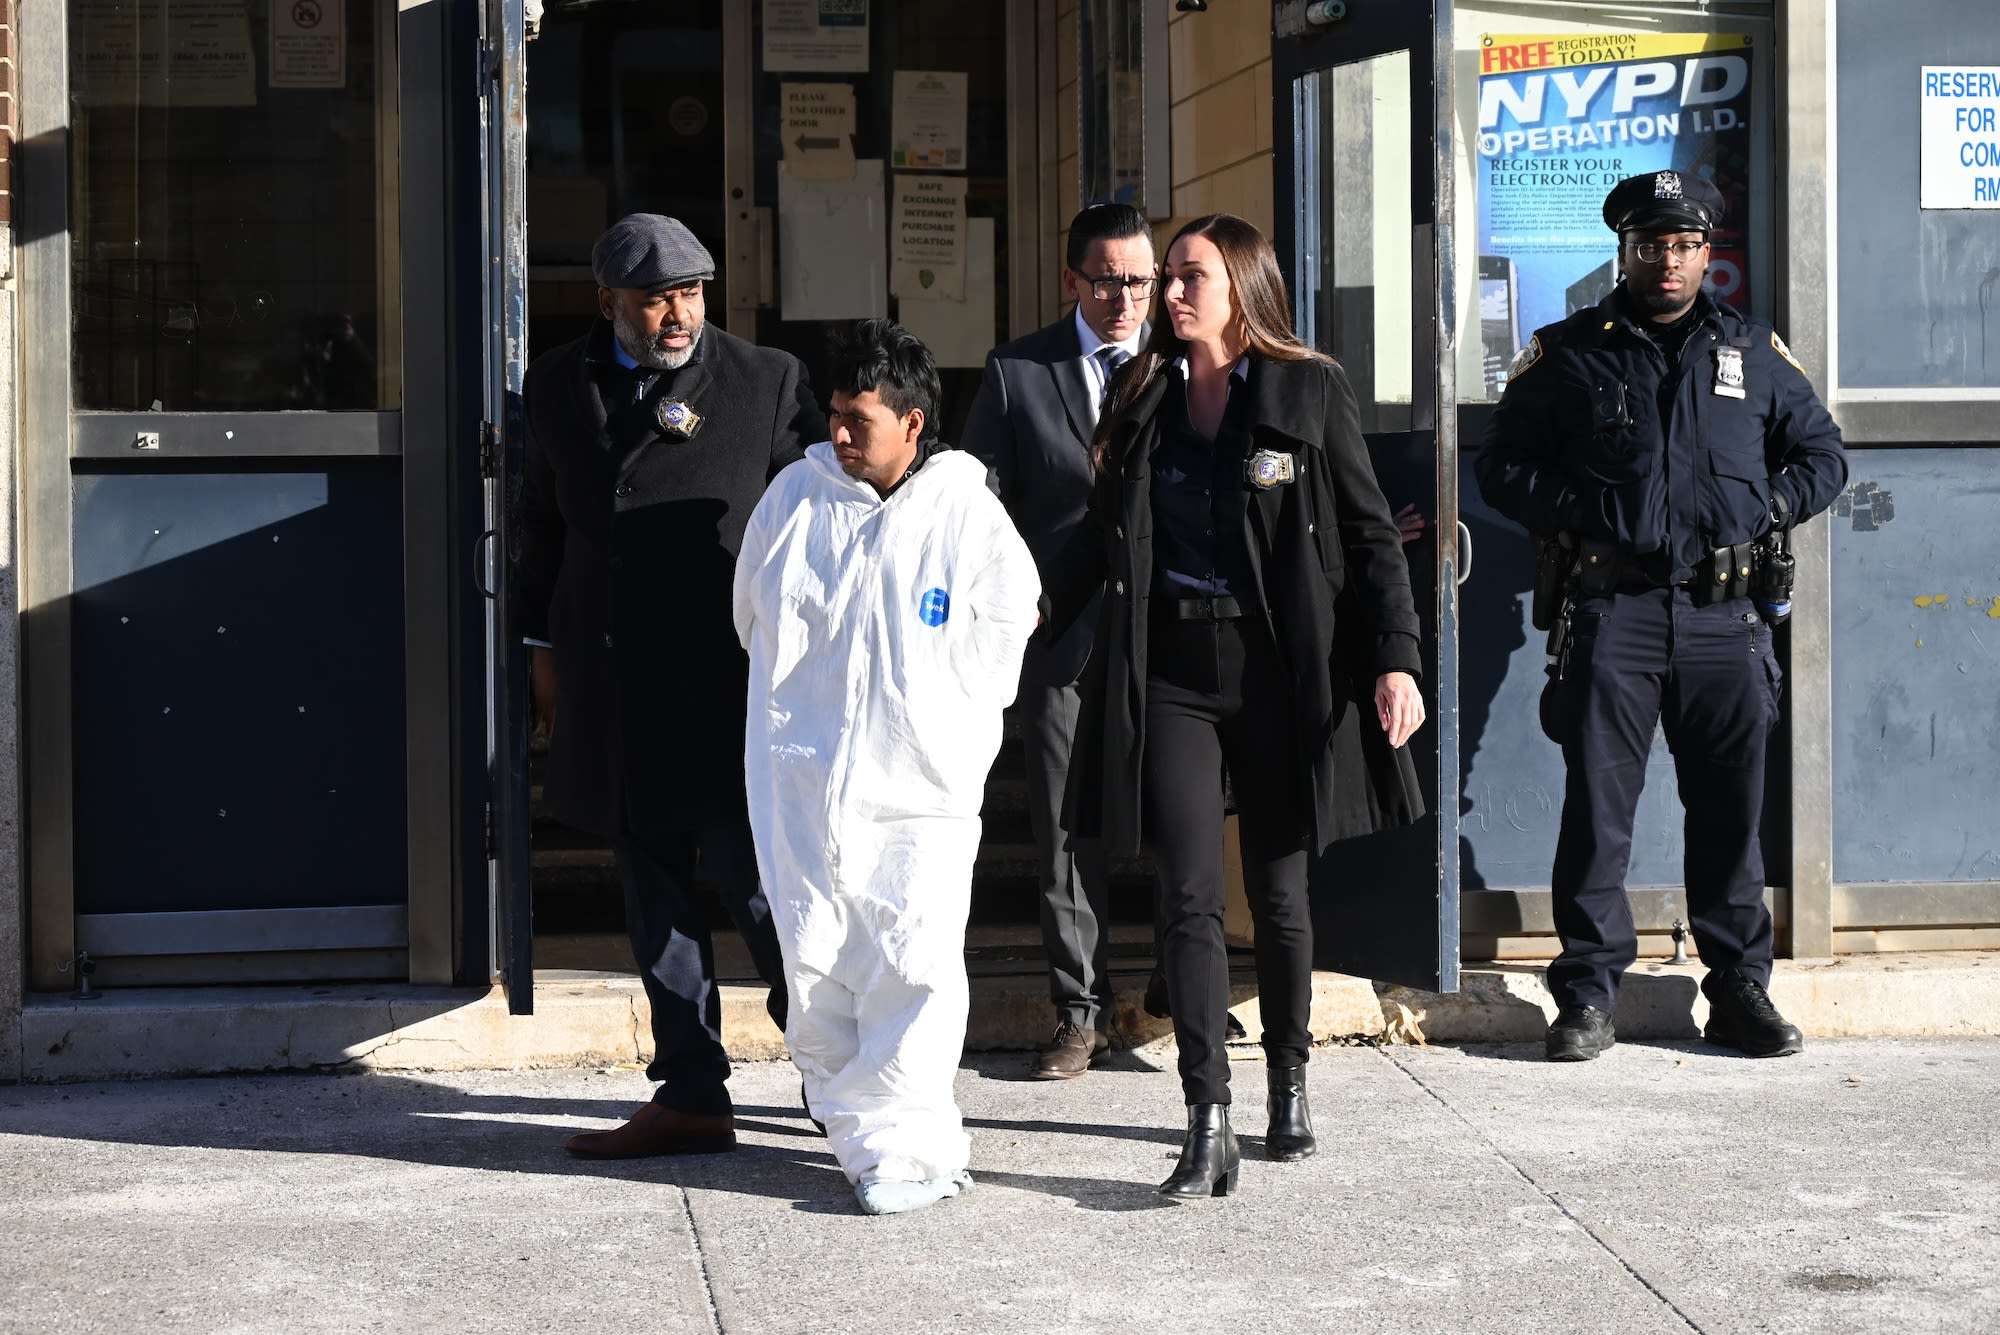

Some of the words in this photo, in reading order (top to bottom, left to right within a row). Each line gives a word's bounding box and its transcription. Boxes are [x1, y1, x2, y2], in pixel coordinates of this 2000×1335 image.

[1558, 34, 1636, 51] REGISTRATION
[1483, 41, 1556, 73] FREE
[1559, 45, 1635, 65] TODAY!
[789, 93, 825, 101] PLEASE
[1479, 55, 1748, 129] NYPD
[789, 106, 807, 114] USE
[810, 106, 846, 115] OTHER
[789, 119, 818, 128] DOOR
[1956, 107, 1995, 132] FOR
[1479, 113, 1679, 156] OPERATION
[1692, 108, 1745, 132] I.D.
[1491, 159, 1569, 171] REGISTER
[1574, 158, 1623, 171] YOUR
[1491, 174, 1597, 186] ELECTRONIC
[918, 183, 943, 191] SAFE
[903, 196, 957, 205] EXCHANGE
[904, 209, 954, 218] INTERNET
[902, 223, 955, 232] PURCHASE
[903, 237, 954, 246] LOCATION
